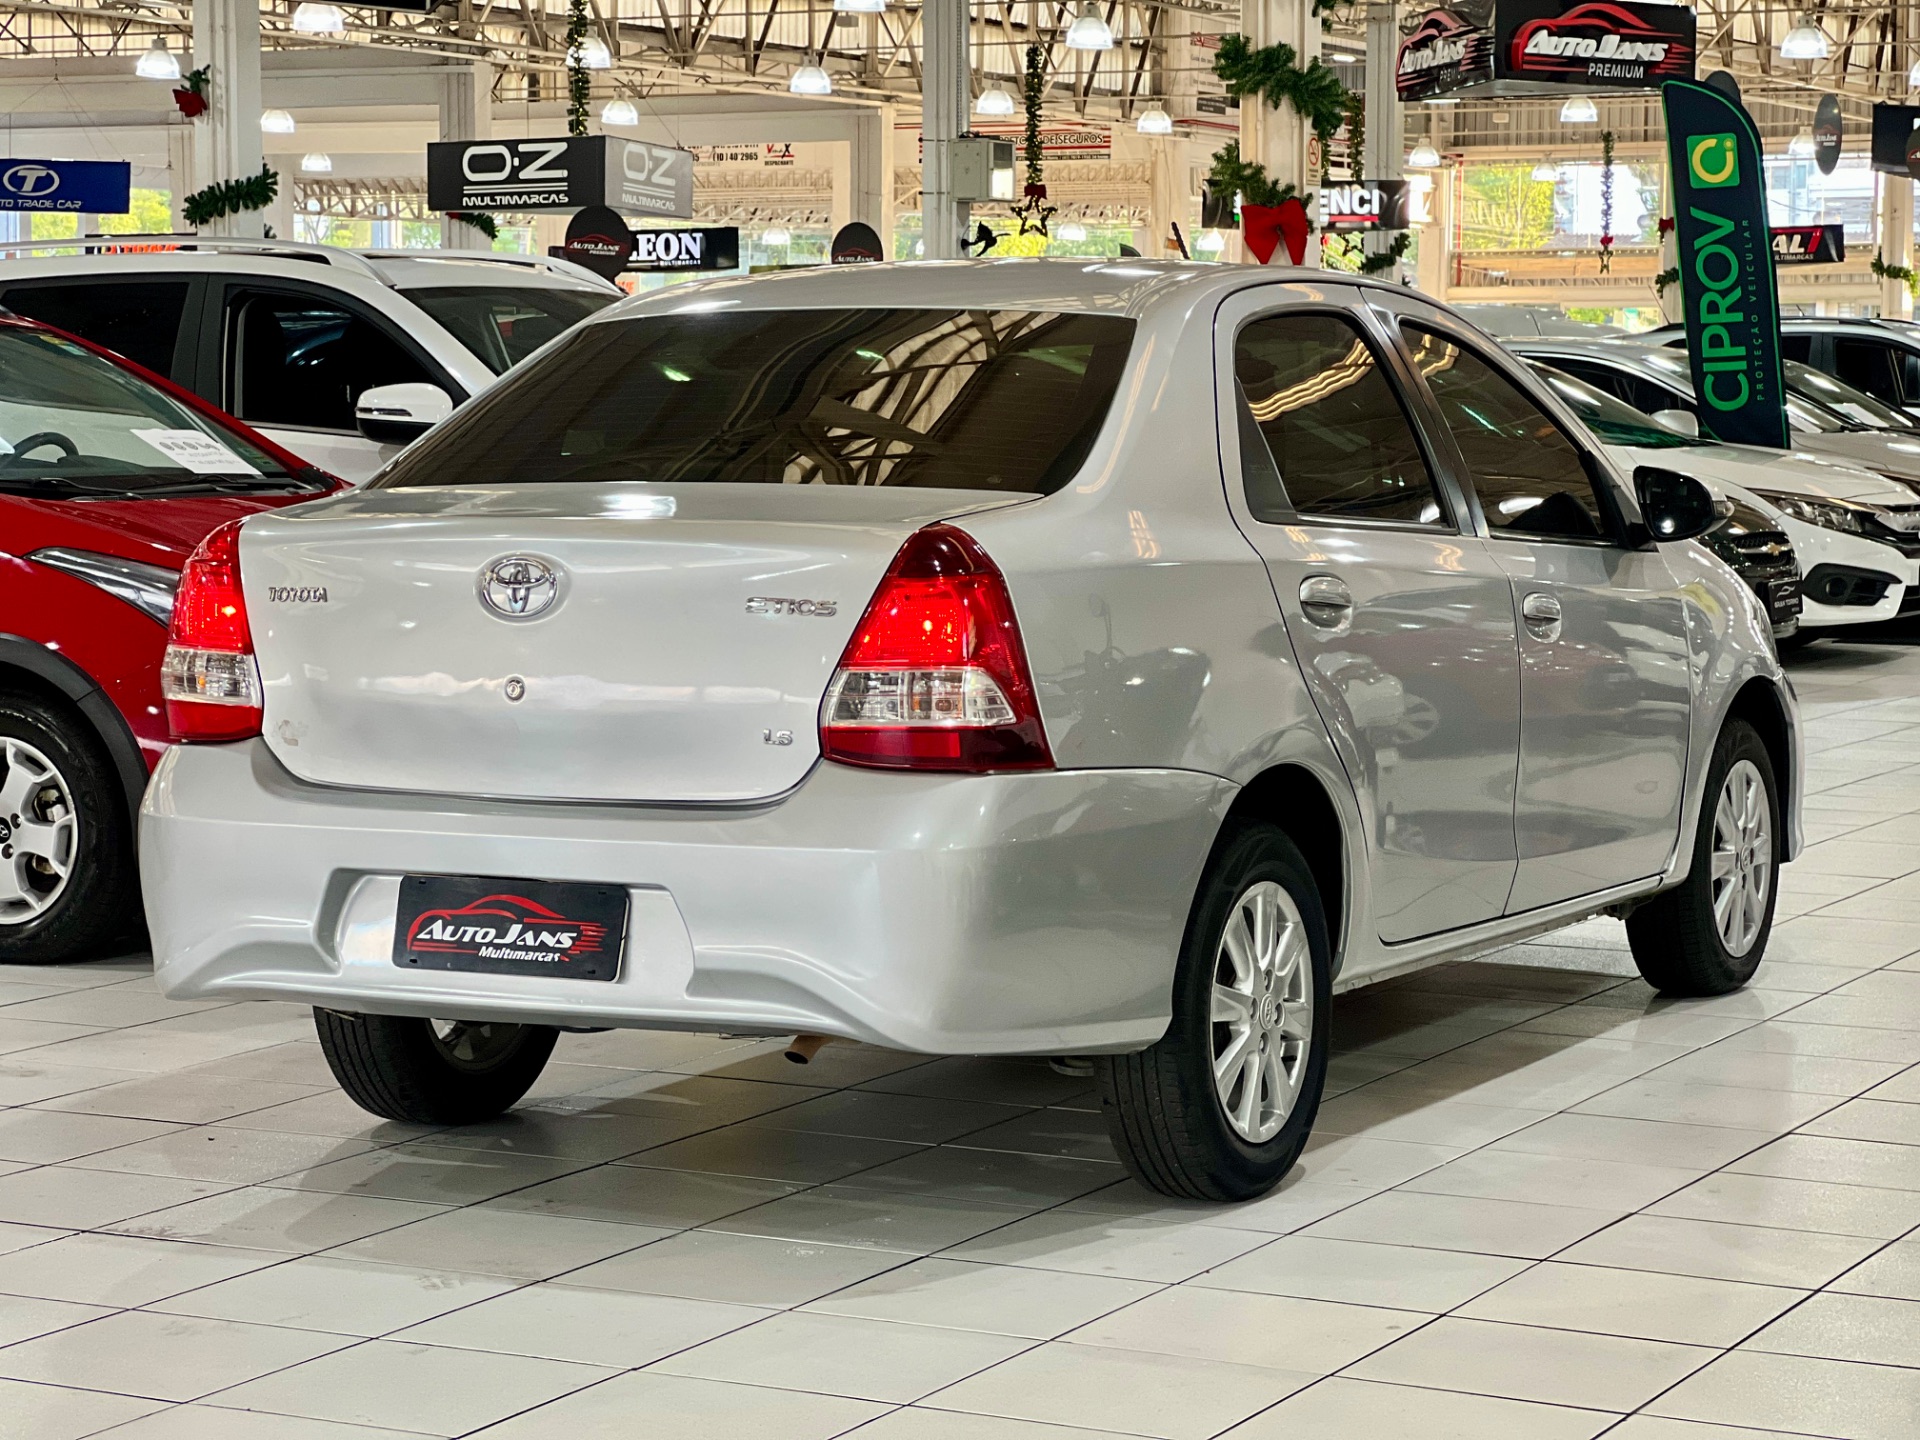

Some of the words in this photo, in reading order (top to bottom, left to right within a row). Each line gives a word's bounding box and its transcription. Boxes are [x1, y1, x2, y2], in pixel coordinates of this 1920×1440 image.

[1588, 62, 1644, 79] PREMIUM
[1057, 133, 1104, 144] SEGUROS
[17, 200, 54, 208] TRADE
[56, 200, 82, 209] CAR
[462, 193, 569, 207] MULTIMARCAS
[621, 193, 676, 211] MULTIMARCAS
[1741, 219, 1757, 302] VEICULAR
[1689, 206, 1750, 411] CIPROV
[1750, 314, 1765, 401] PROTEÇÃO
[268, 587, 328, 602] TOYOTA
[745, 597, 837, 617] ETIOS
[478, 945, 561, 963] Multimarcas
